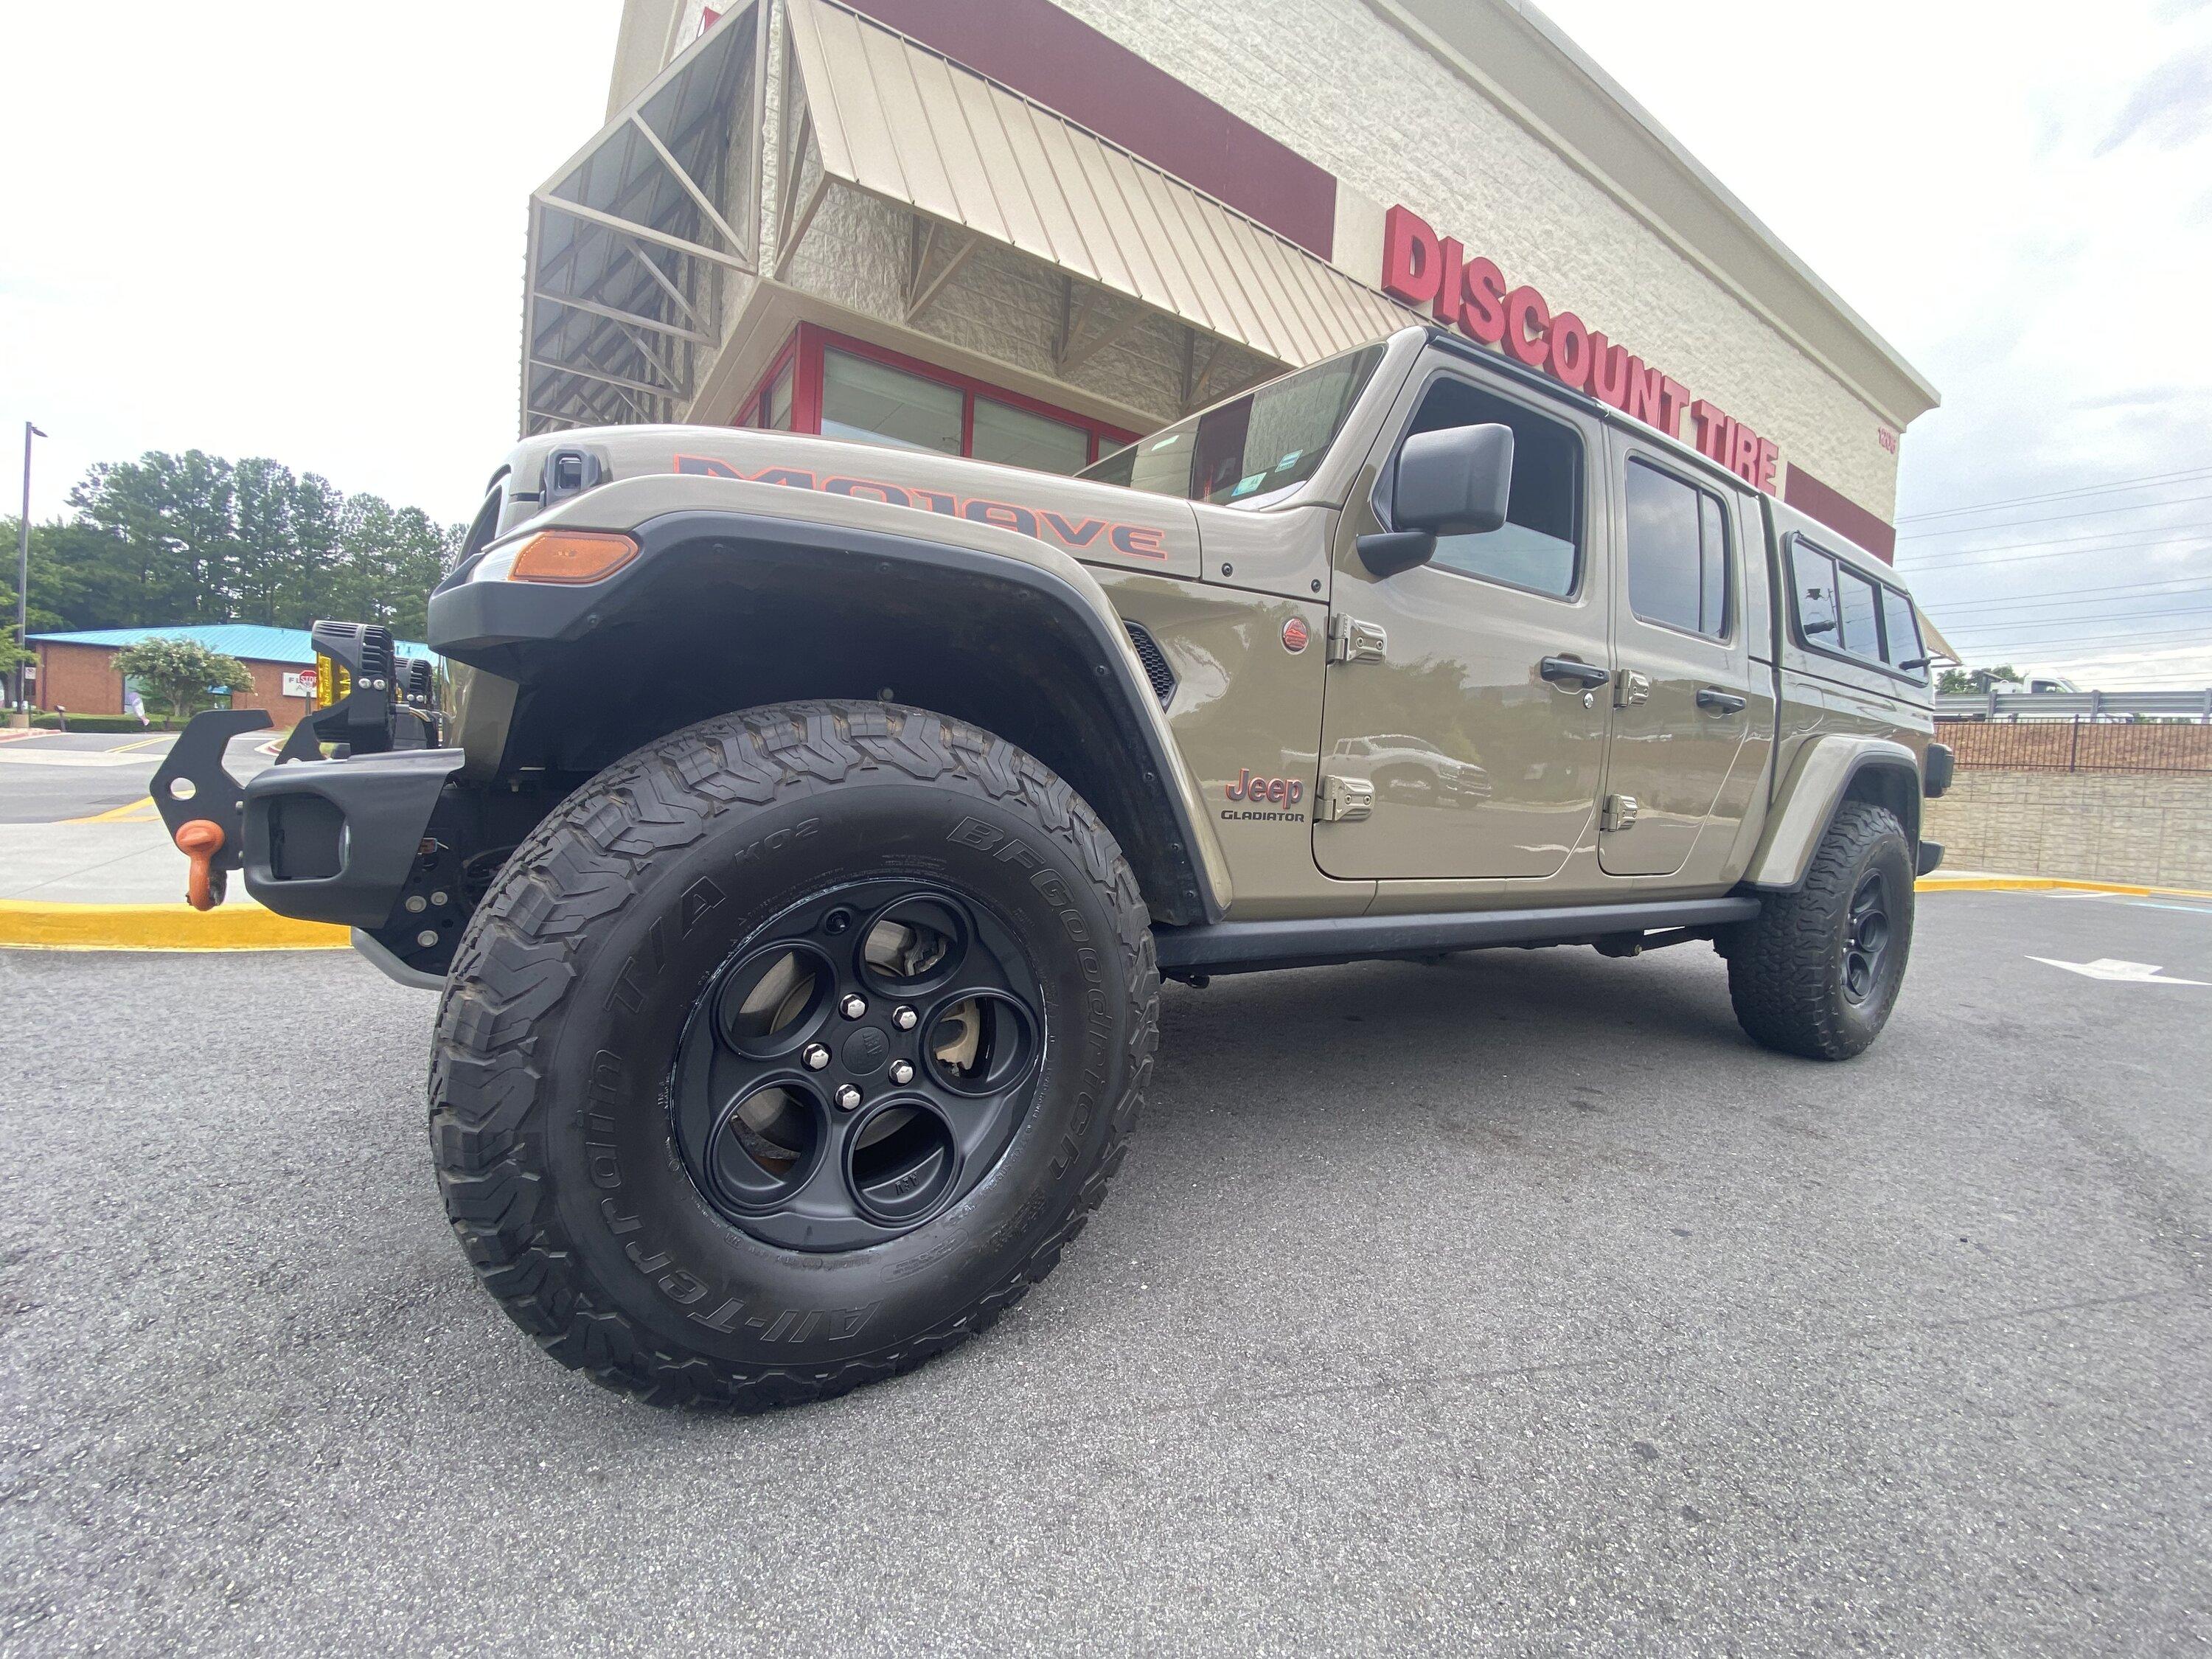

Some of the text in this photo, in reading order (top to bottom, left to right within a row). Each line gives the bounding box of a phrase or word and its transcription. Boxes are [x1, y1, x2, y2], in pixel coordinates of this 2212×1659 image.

[1381, 204, 1779, 498] DISCOUNT TIRE
[1221, 810, 1304, 822] GLADIATOR
[1226, 768, 1304, 810] Jeep
[604, 875, 727, 1014] T/A
[734, 817, 821, 865] KO2
[946, 815, 1113, 1180] BFGoodrich
